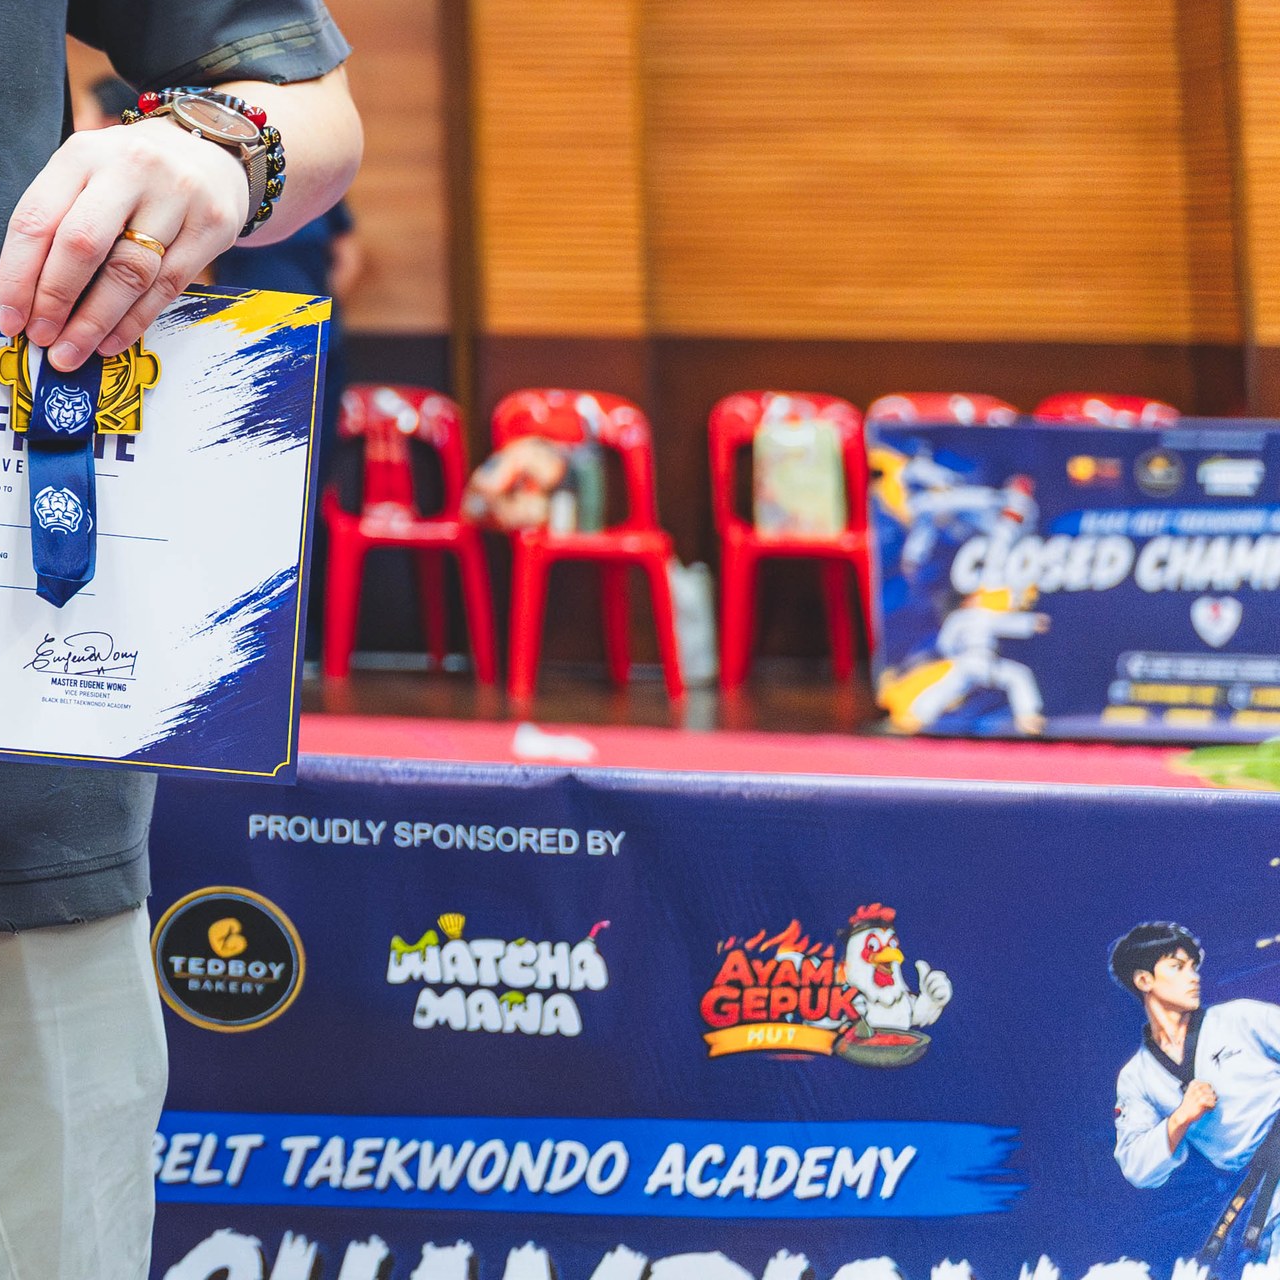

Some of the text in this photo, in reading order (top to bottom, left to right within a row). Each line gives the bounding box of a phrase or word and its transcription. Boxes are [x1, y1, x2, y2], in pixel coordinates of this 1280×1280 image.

[3, 485, 13, 493] TO
[950, 533, 1136, 594] CLOSED
[51, 677, 127, 692] MASTER EUGENE WONG
[64, 689, 111, 699] VICE PRESIDENT
[41, 696, 58, 704] BLACK
[73, 699, 106, 708] TAEKWONDO
[107, 702, 132, 710] ACADEMY
[248, 814, 626, 857] PROUDLY SPONSORED BY
[169, 955, 286, 980] TEDBOY
[713, 949, 835, 986] AYAM
[188, 979, 266, 996] BAKERY
[699, 984, 860, 1028] GEPUK
[747, 1026, 797, 1046] HUT
[280, 1134, 630, 1196] TAEKWONDO
[644, 1142, 918, 1200] ACADEMY
